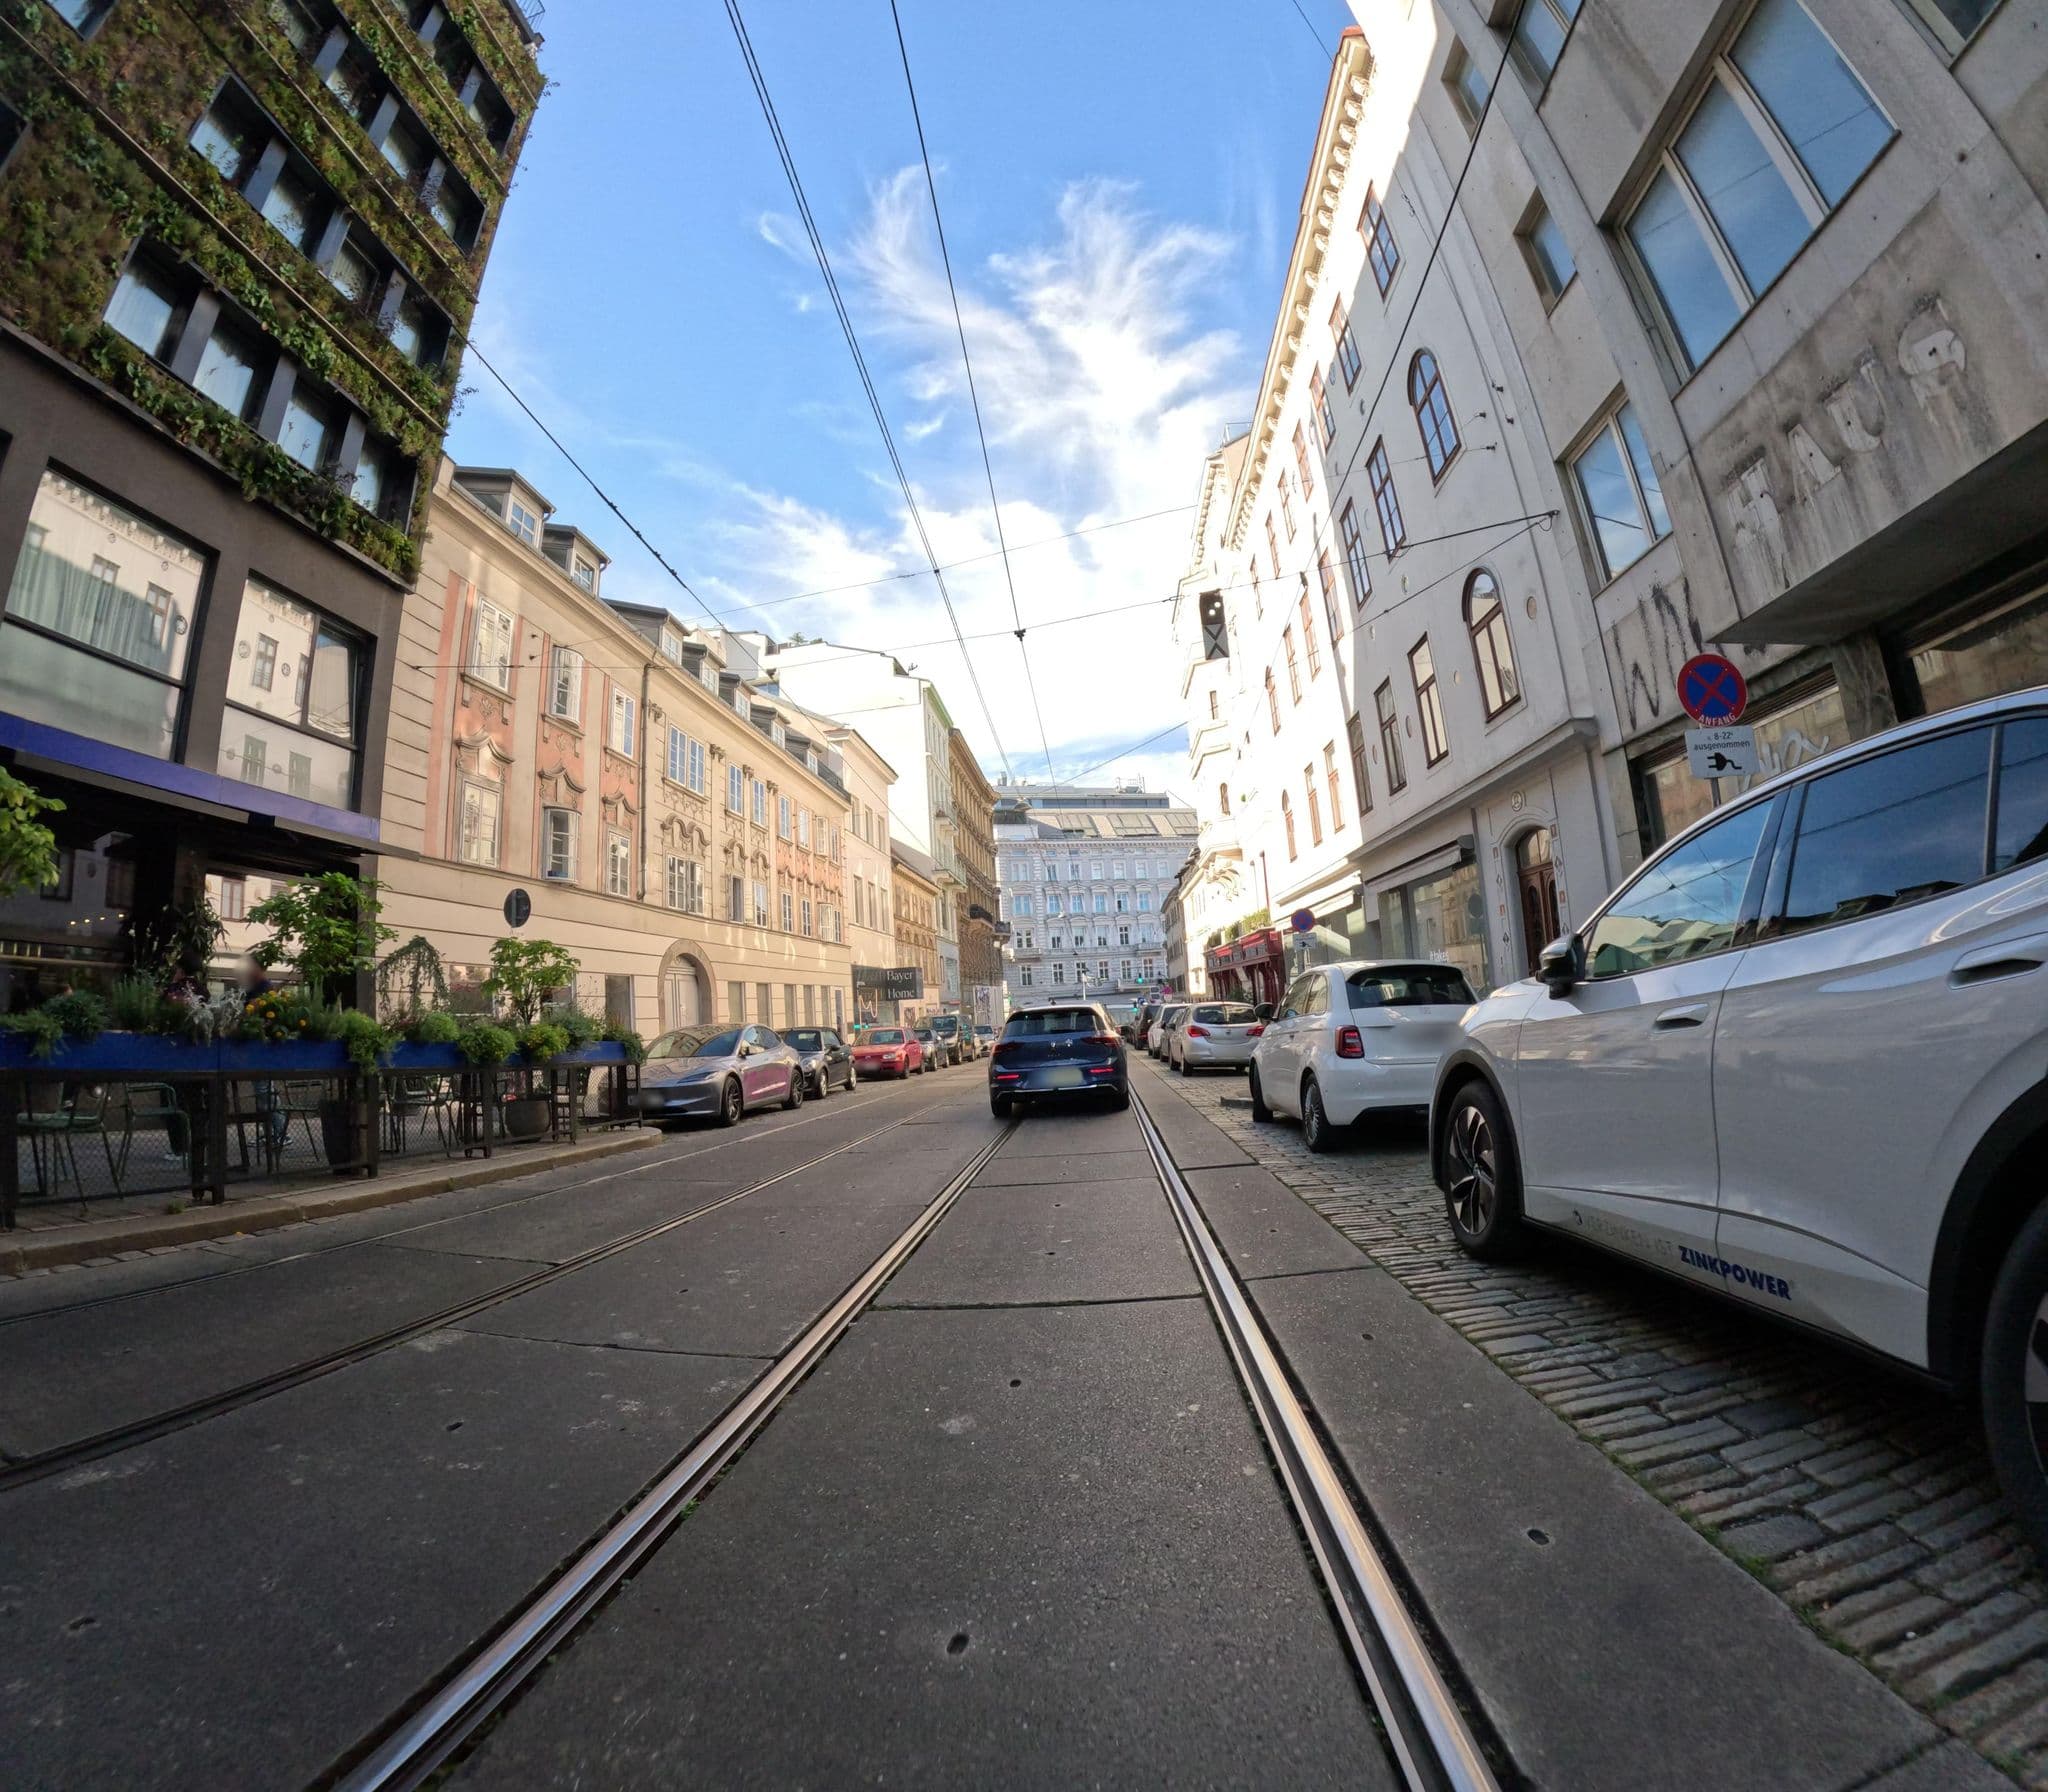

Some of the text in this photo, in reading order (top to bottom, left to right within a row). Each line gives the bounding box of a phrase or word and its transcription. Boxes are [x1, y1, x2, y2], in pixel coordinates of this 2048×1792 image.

[1698, 712, 1736, 726] ANFANG
[1694, 741, 1750, 750] ausgenommen
[886, 970, 912, 984] Bayer
[887, 988, 915, 999] Home
[1678, 1244, 1793, 1301] ZINKPOWER
